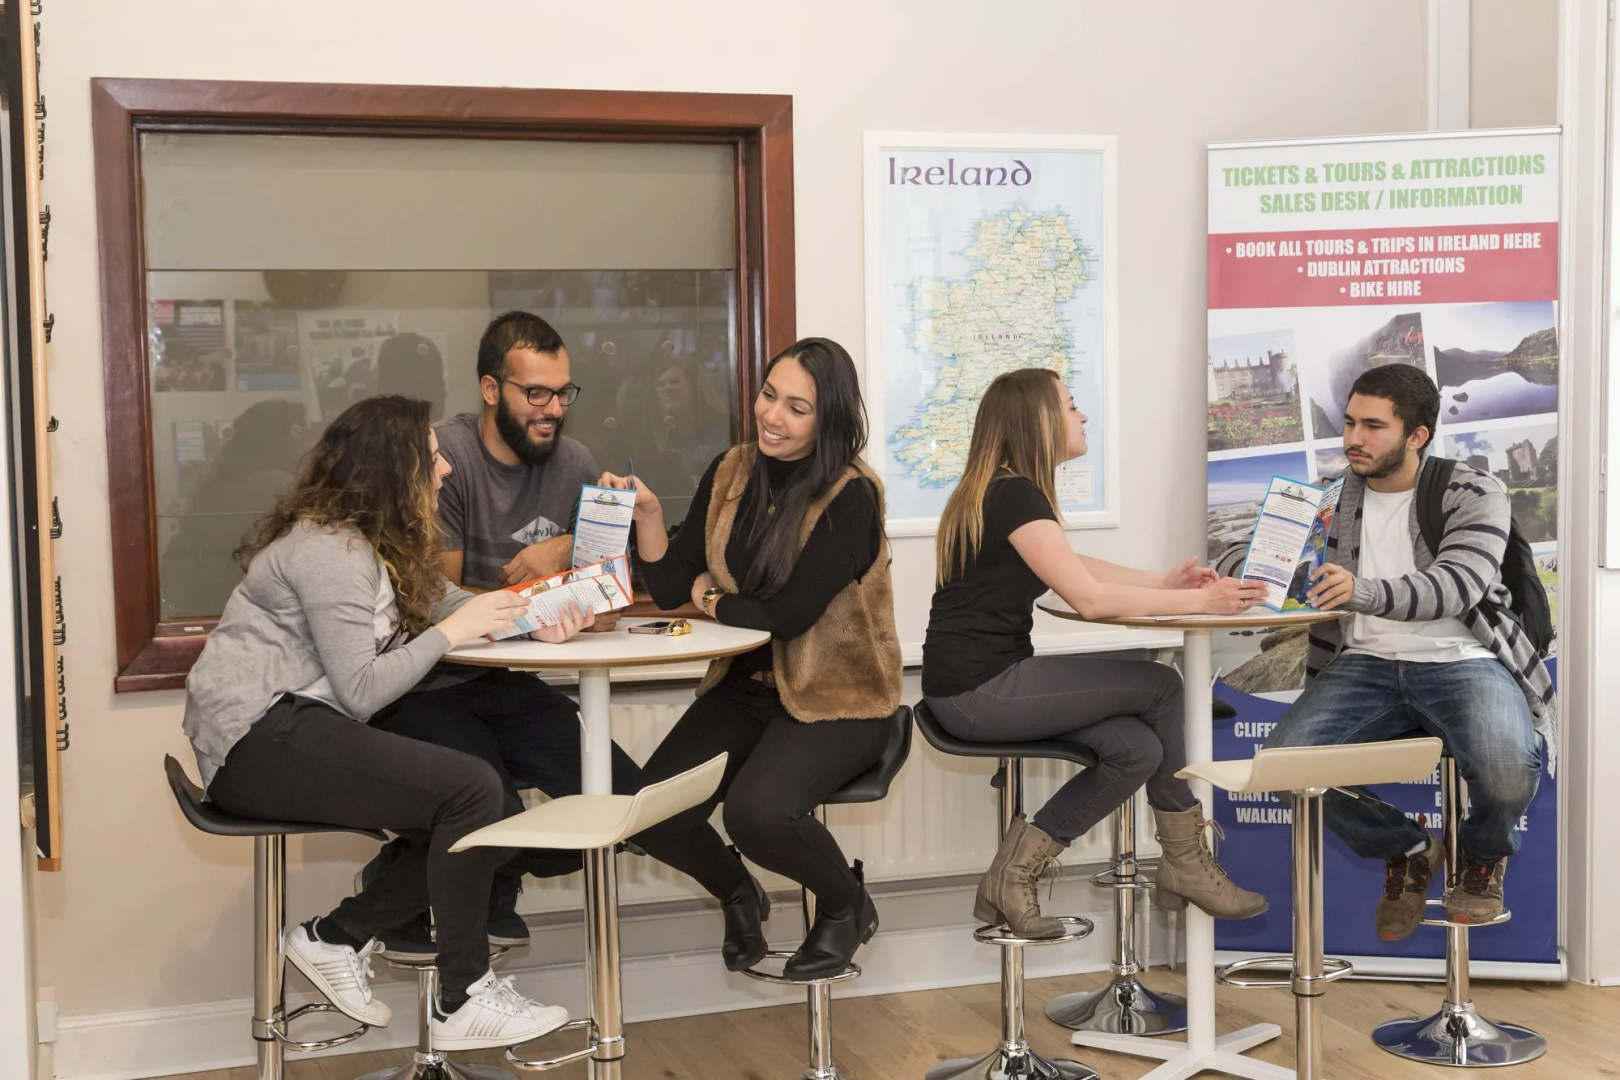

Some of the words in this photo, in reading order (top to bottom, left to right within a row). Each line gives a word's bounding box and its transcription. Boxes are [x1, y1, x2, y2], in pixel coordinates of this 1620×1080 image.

[889, 157, 1032, 186] Ireland
[1222, 165, 1300, 187] TICKETS
[1304, 167, 1318, 184] &
[1323, 161, 1387, 183] TOURS
[1391, 163, 1406, 180] &
[1410, 154, 1545, 180] ATTRACTIONS
[1260, 192, 1316, 214] SALES
[1321, 190, 1371, 212] DESK
[1374, 189, 1385, 210] /
[1389, 184, 1523, 209] INFORMATION
[1236, 241, 1276, 258] BOOK
[1279, 240, 1303, 257] ALL
[1305, 239, 1354, 256] TOURS
[1357, 240, 1369, 254] &
[1371, 236, 1415, 254] TRIPS
[1418, 236, 1434, 252] IN
[1437, 233, 1500, 252] IRELAND
[1503, 232, 1541, 250] HERE
[1307, 260, 1360, 277] DUBLIN
[1363, 257, 1466, 276] ATTRACTIONS
[1350, 281, 1384, 298] BIKE
[1387, 280, 1421, 297] HIRE
[1236, 807, 1292, 825] WALKIN
